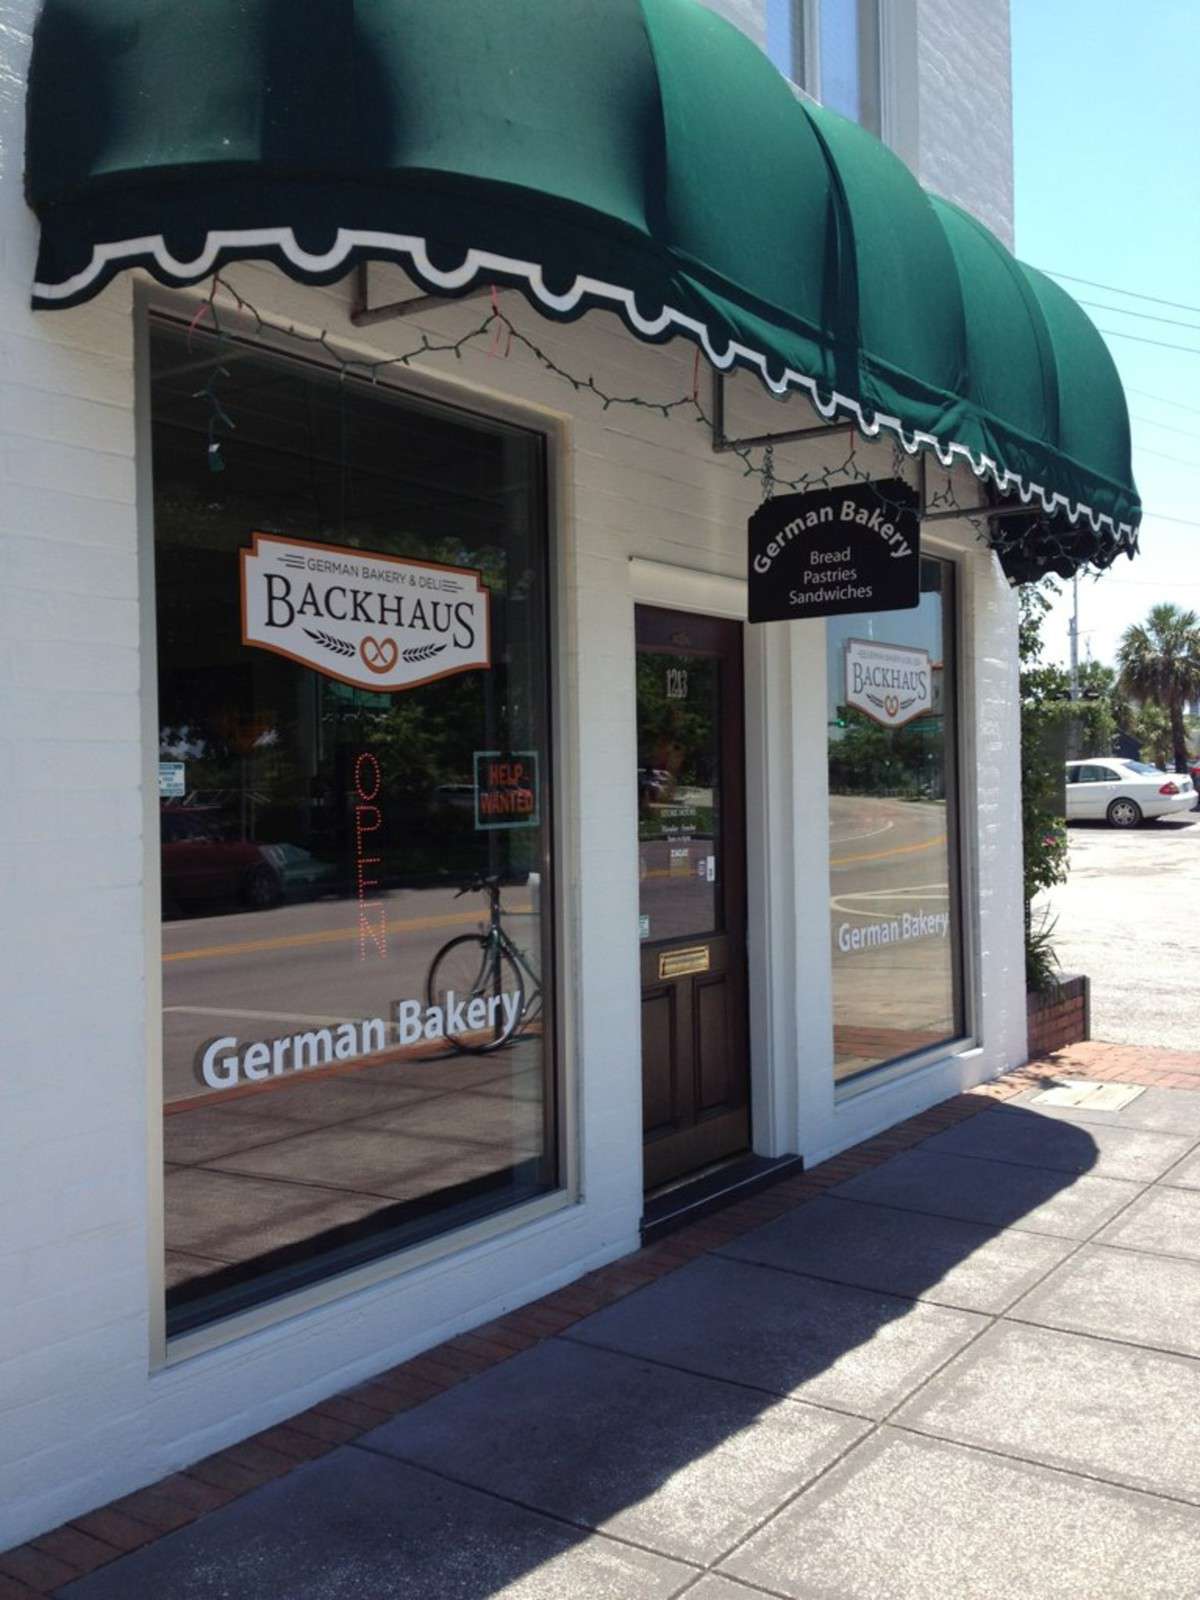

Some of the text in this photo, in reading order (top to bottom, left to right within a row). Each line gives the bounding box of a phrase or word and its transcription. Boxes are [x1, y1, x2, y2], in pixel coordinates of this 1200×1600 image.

[753, 500, 913, 574] German Bakery
[810, 547, 851, 565] Bread
[307, 558, 440, 591] GERMAN BAKERY & DELI
[803, 567, 857, 585] Pastries
[263, 573, 475, 650] BACKHAUS
[789, 584, 873, 605] Sandwiches
[852, 662, 927, 701] BACKHAUS
[489, 761, 524, 786] HELP
[480, 788, 534, 816] WANTED
[355, 752, 387, 961] OPEN
[838, 909, 950, 952] German Bakery
[202, 990, 521, 1090] German Bakery
